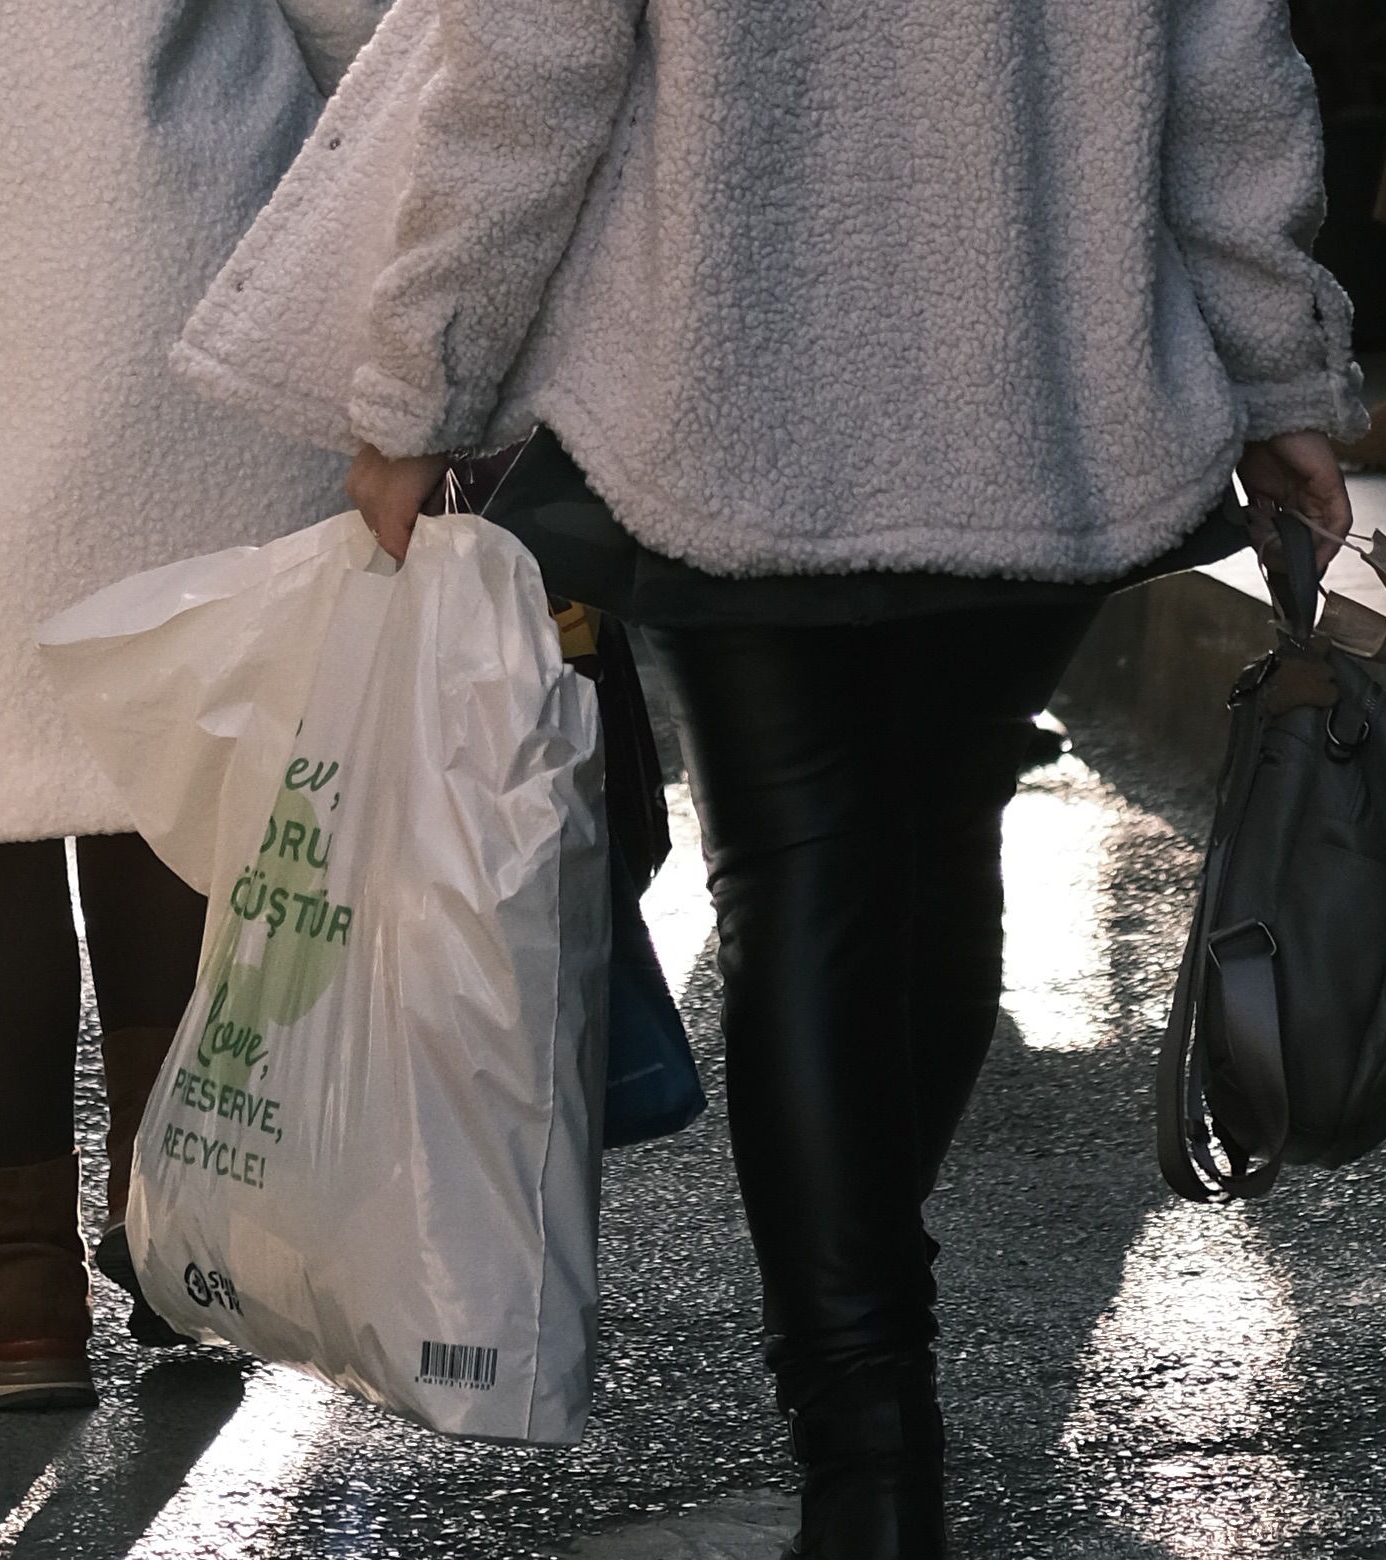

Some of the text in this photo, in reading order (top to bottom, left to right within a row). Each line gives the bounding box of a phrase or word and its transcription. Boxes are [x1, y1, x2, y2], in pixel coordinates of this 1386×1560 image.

[197, 982, 269, 1080] Love,
[172, 1066, 283, 1145] PESERVE,
[160, 1122, 266, 1190] RECYCLE!
